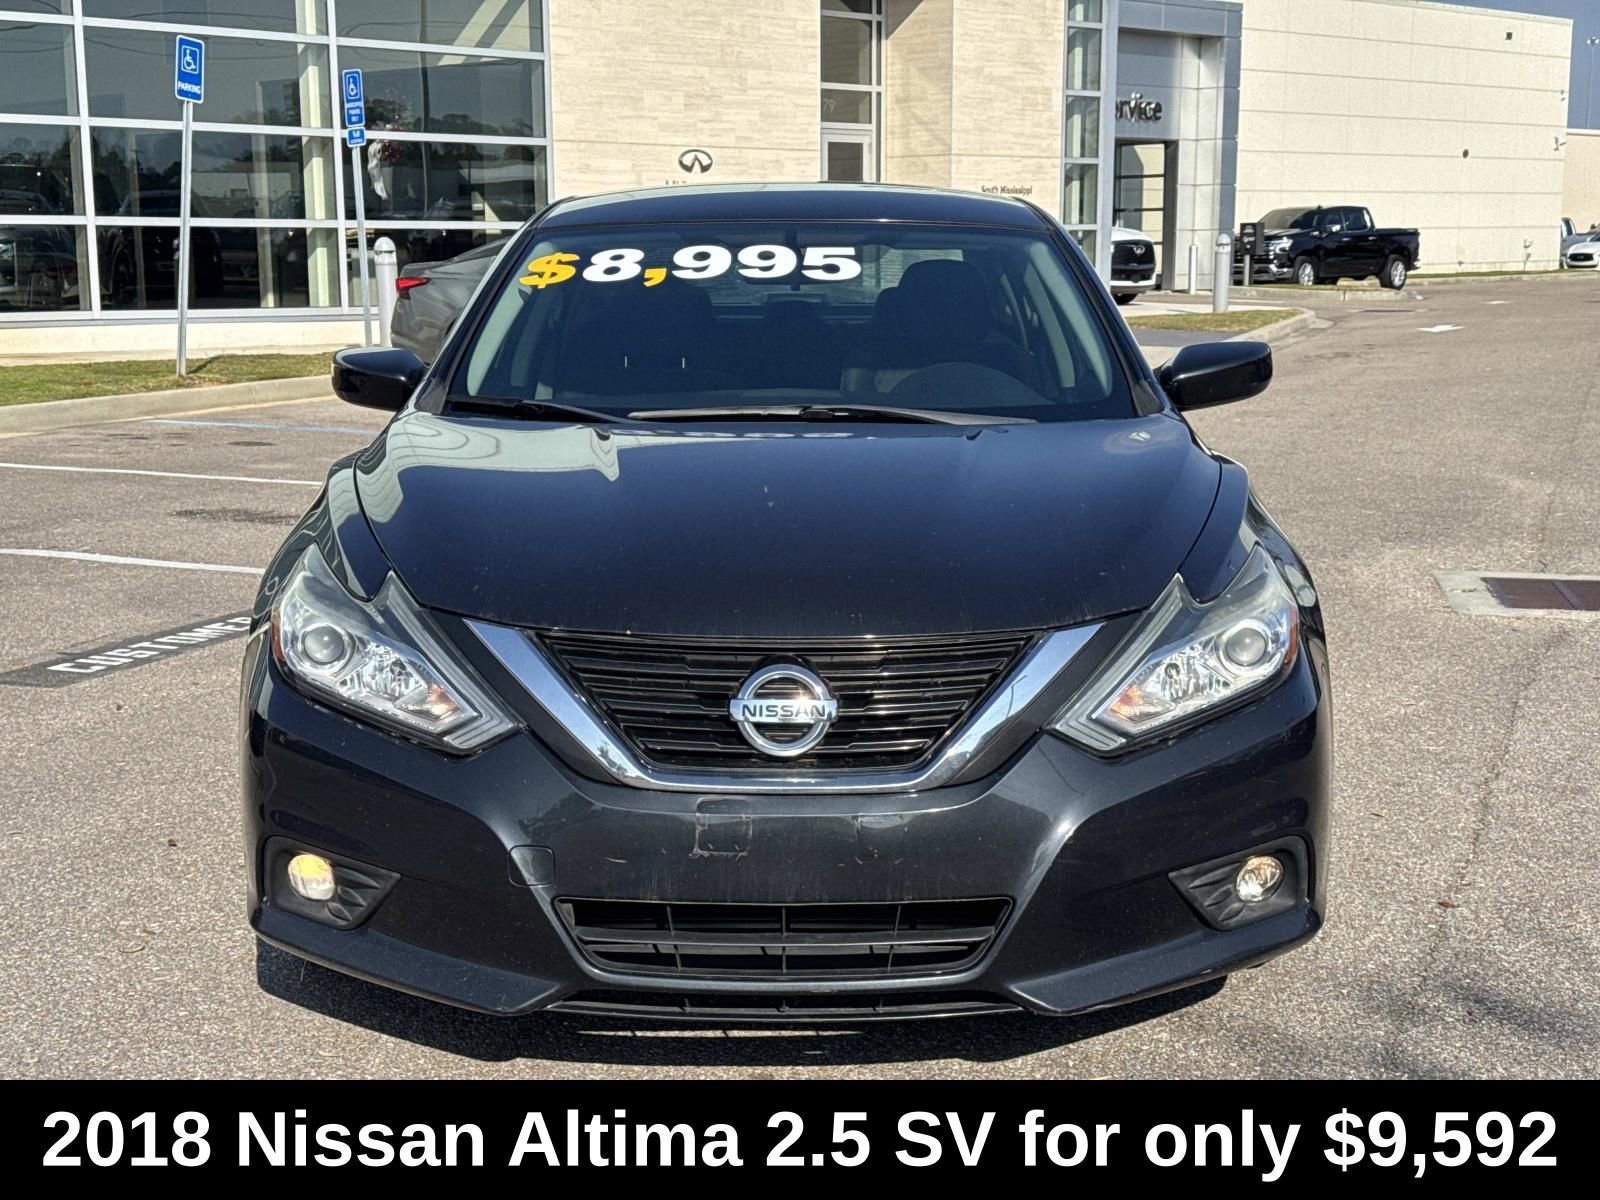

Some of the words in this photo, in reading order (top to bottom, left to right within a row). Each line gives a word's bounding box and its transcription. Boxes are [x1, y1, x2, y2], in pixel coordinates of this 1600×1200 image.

[177, 80, 201, 94] PARKING
[519, 244, 862, 288] $8,995
[741, 704, 826, 718] NISSAN
